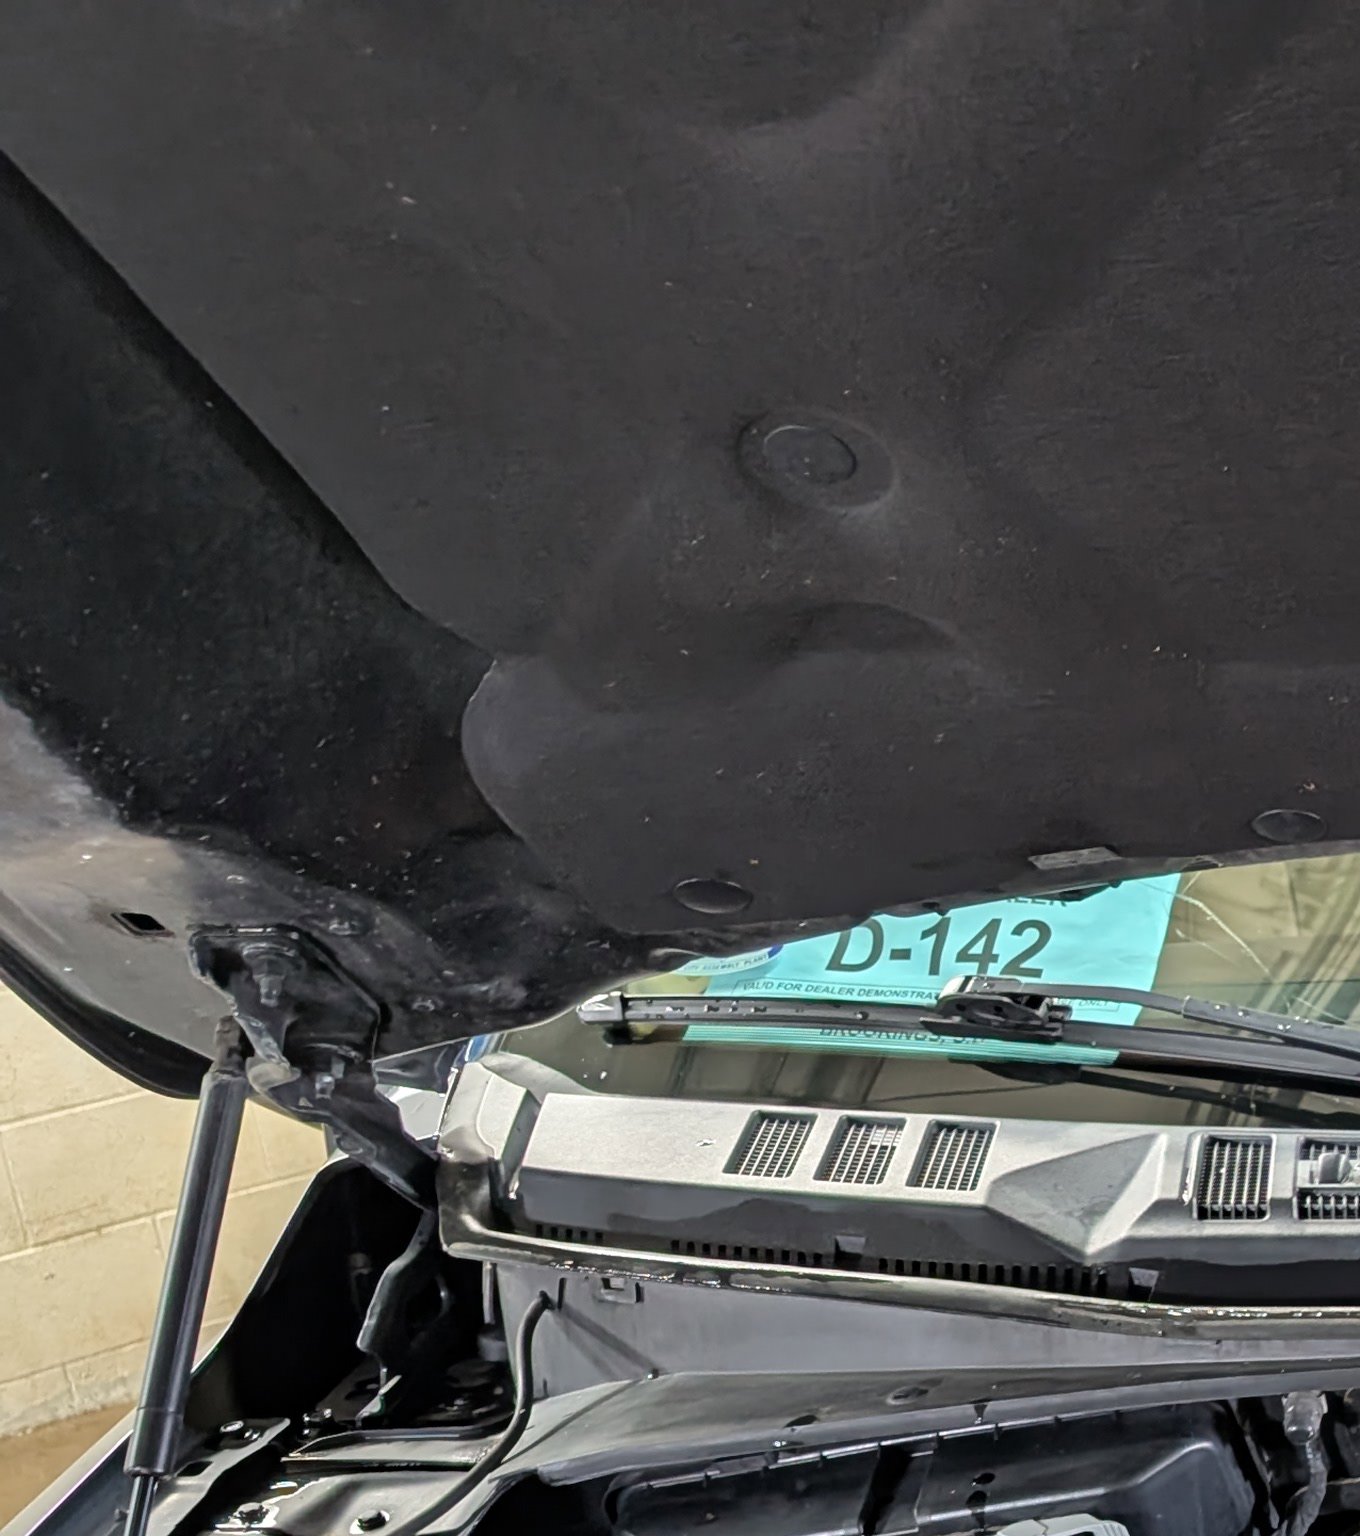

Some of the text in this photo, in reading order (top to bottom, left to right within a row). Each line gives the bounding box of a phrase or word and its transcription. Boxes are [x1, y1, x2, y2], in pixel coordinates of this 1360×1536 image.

[825, 916, 1052, 979] D-142
[743, 981, 774, 992] VALID
[776, 981, 803, 993] FOR
[804, 984, 856, 996] DEALER
